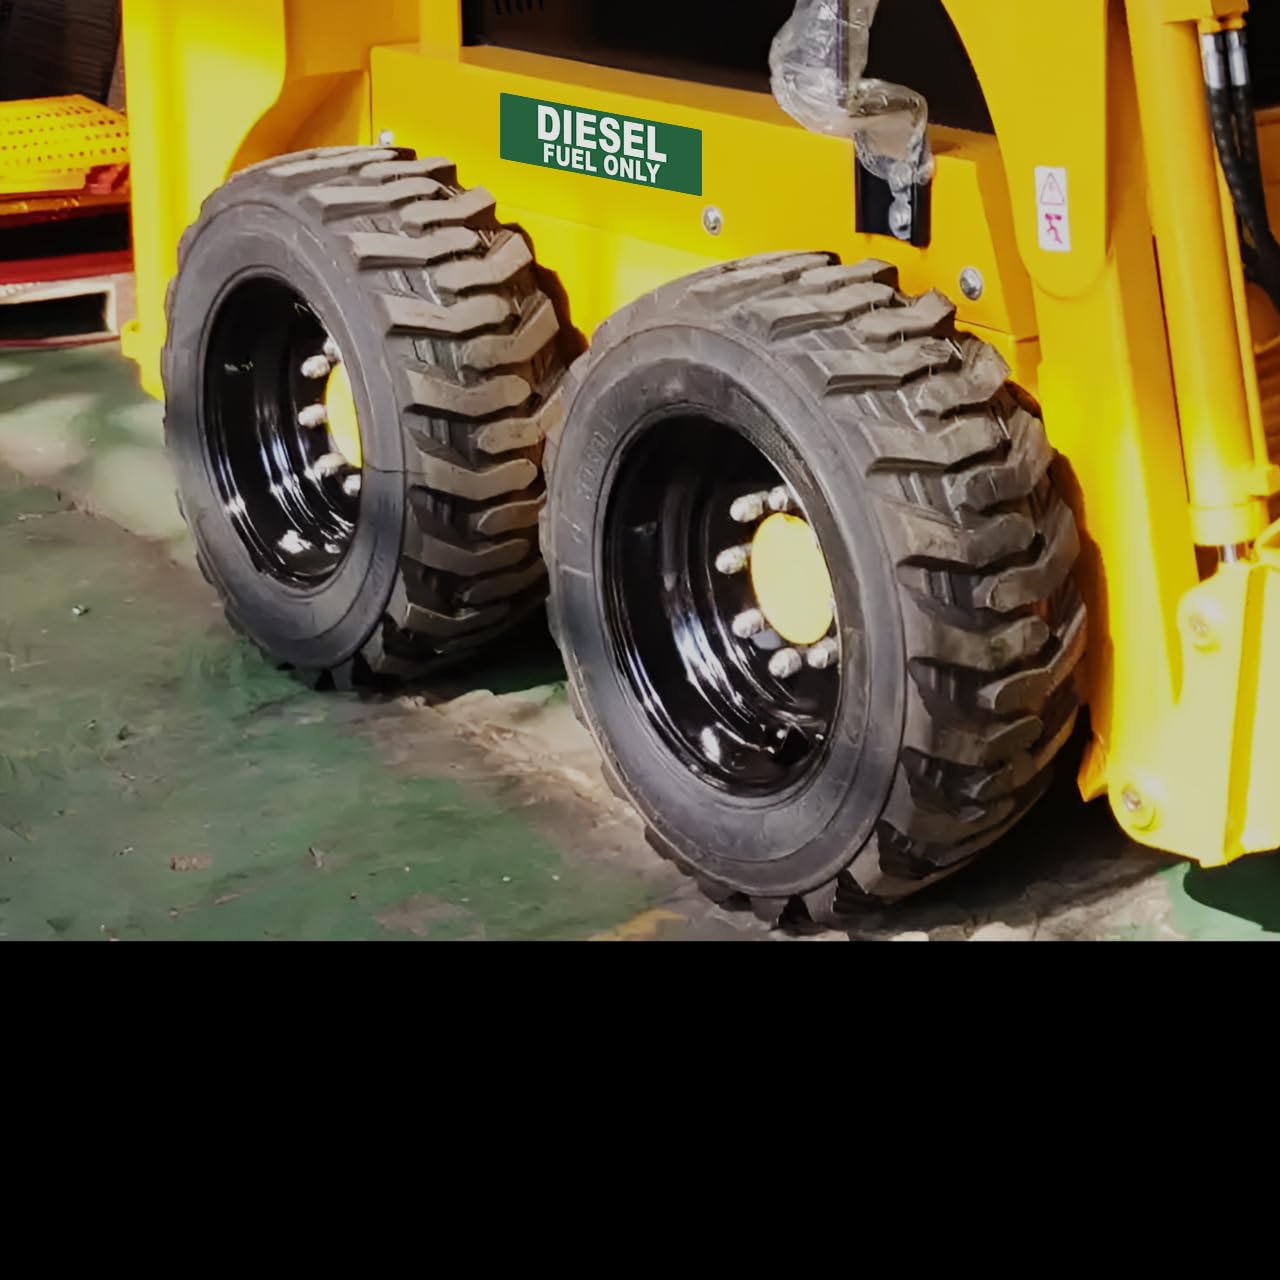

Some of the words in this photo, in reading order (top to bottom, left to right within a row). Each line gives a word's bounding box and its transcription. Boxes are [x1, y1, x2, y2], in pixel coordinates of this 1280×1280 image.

[537, 104, 667, 163] DIESEL
[543, 142, 598, 173] FUEL
[603, 154, 661, 184] ONLY
